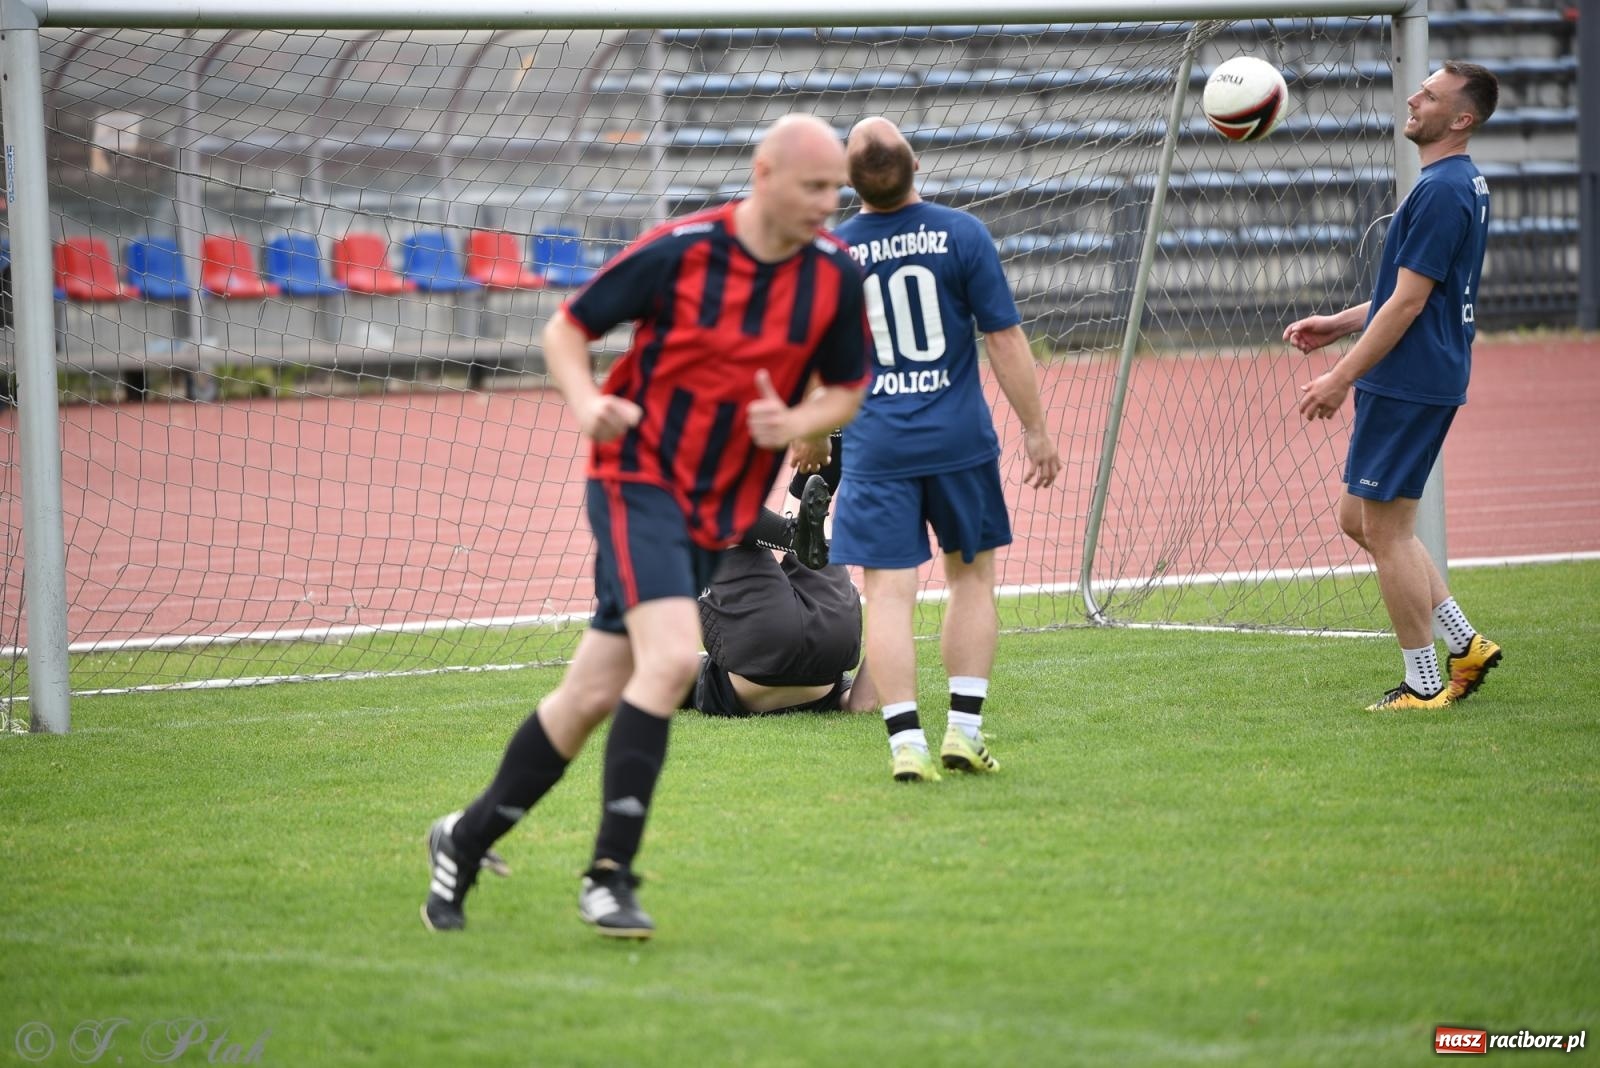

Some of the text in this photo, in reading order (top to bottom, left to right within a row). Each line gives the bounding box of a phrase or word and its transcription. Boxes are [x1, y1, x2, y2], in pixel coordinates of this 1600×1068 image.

[848, 243, 869, 266] PP
[870, 223, 948, 263] RACIBÓRZ
[863, 264, 946, 366] 10
